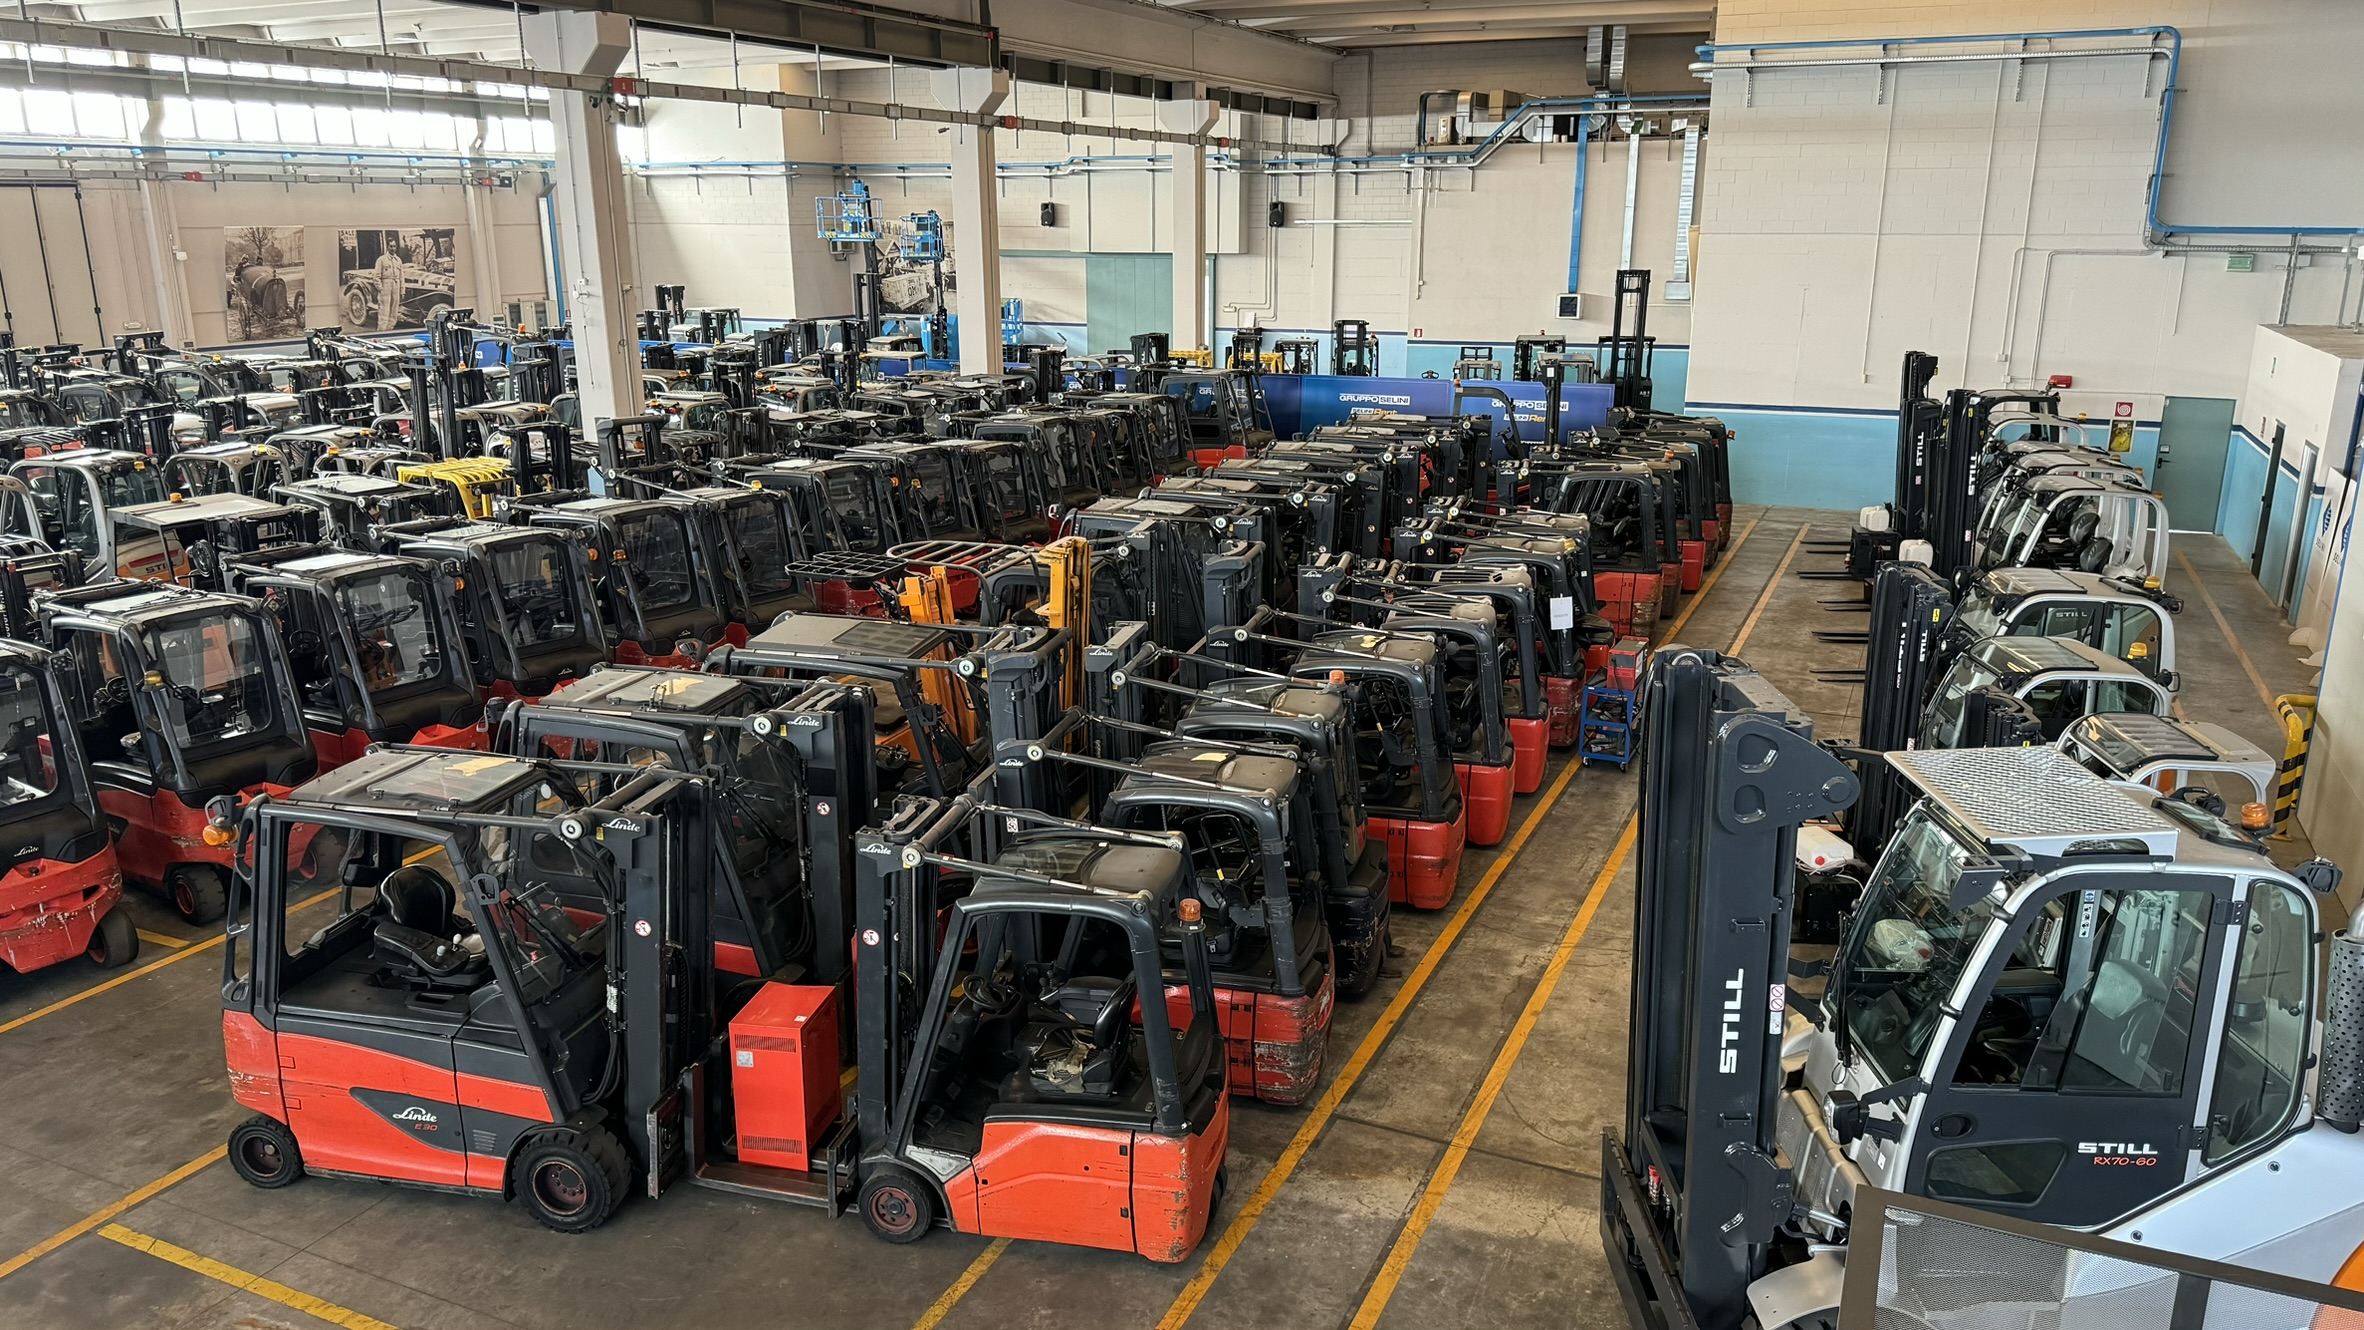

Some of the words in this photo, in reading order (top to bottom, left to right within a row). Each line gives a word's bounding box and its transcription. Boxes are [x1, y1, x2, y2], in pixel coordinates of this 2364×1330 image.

[1339, 394, 1378, 403] GRUPPO
[1379, 396, 1409, 405] SELINI
[1916, 432, 1924, 467] STILL
[1968, 452, 1978, 495] STILL
[1233, 517, 1254, 525] Linde
[1919, 629, 1928, 662] STILL
[1089, 648, 1113, 656] Linde
[787, 715, 821, 727] Linde
[999, 758, 1024, 767] Linde
[601, 817, 640, 832] Linde
[859, 843, 892, 855] Linde
[1719, 968, 1744, 1073] STILL
[392, 1106, 438, 1123] Linde
[2077, 1142, 2158, 1155] STILL
[2093, 1156, 2157, 1167] RX70-60
